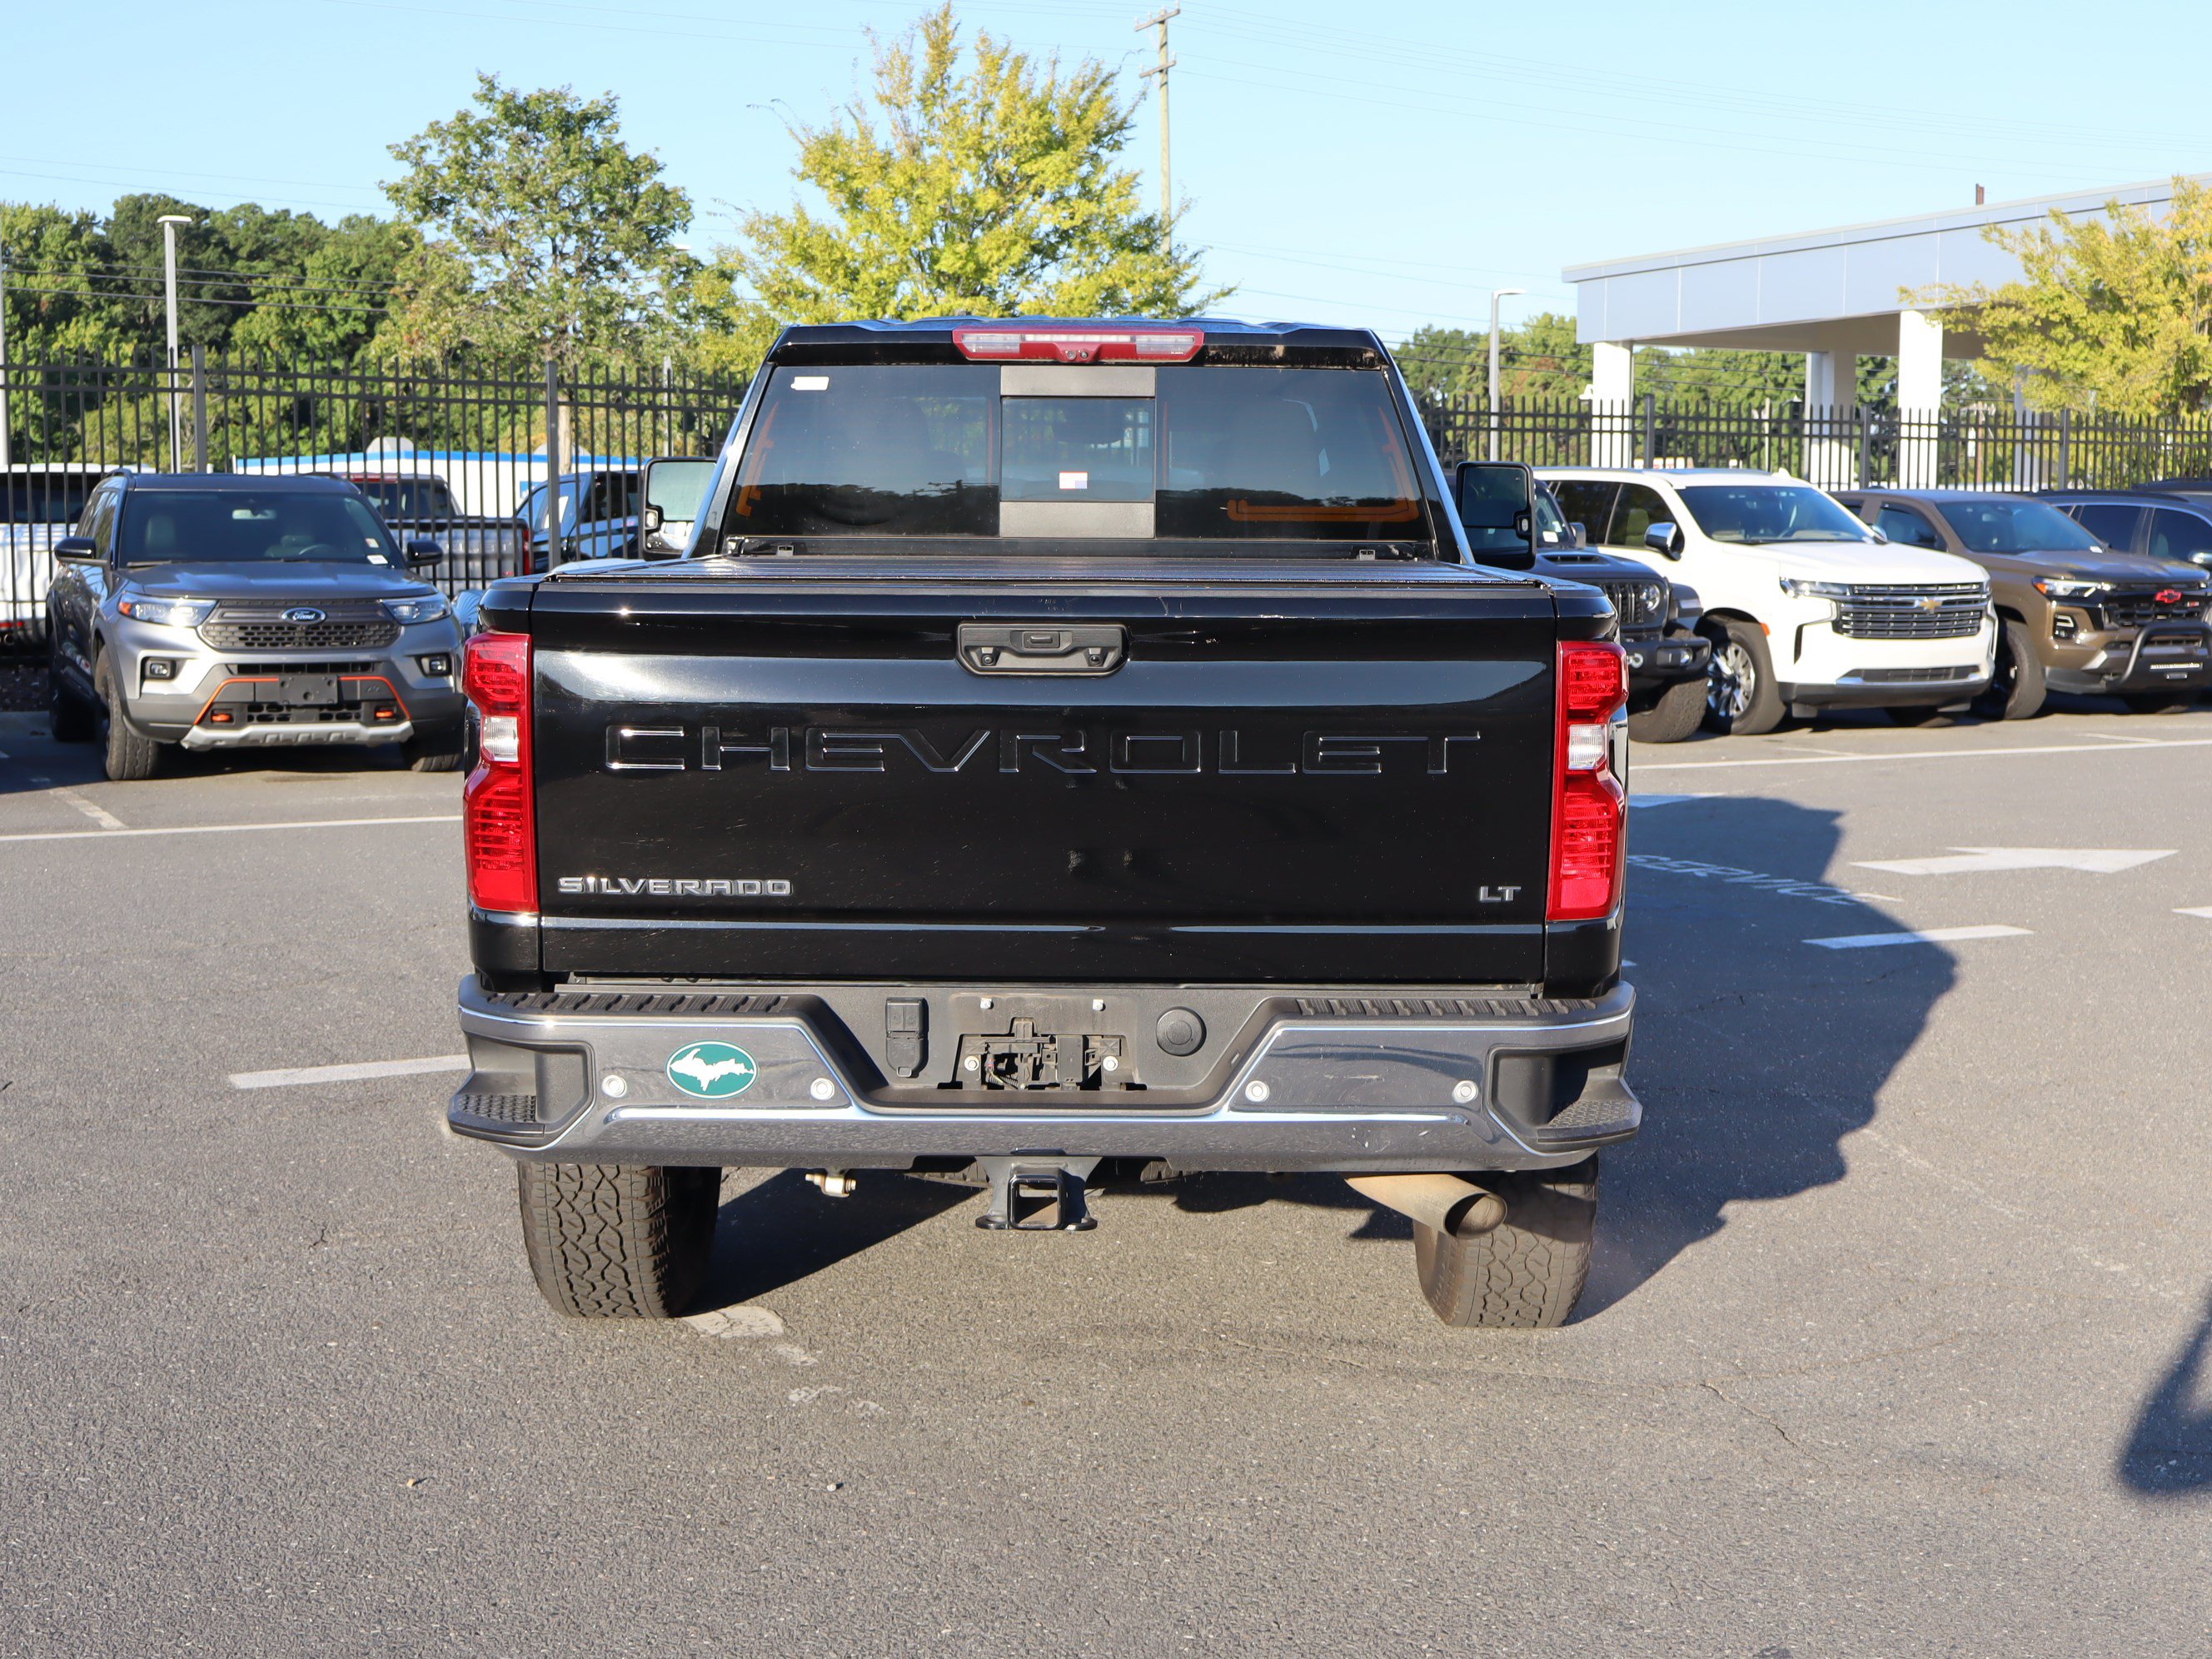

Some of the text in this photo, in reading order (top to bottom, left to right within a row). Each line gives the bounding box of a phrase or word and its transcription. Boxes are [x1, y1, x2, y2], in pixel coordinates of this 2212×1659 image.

[292, 610, 316, 620] Ford
[605, 725, 1482, 775] CHEVROLET
[558, 876, 793, 896] SILVERADO
[1479, 885, 1522, 902] LT
